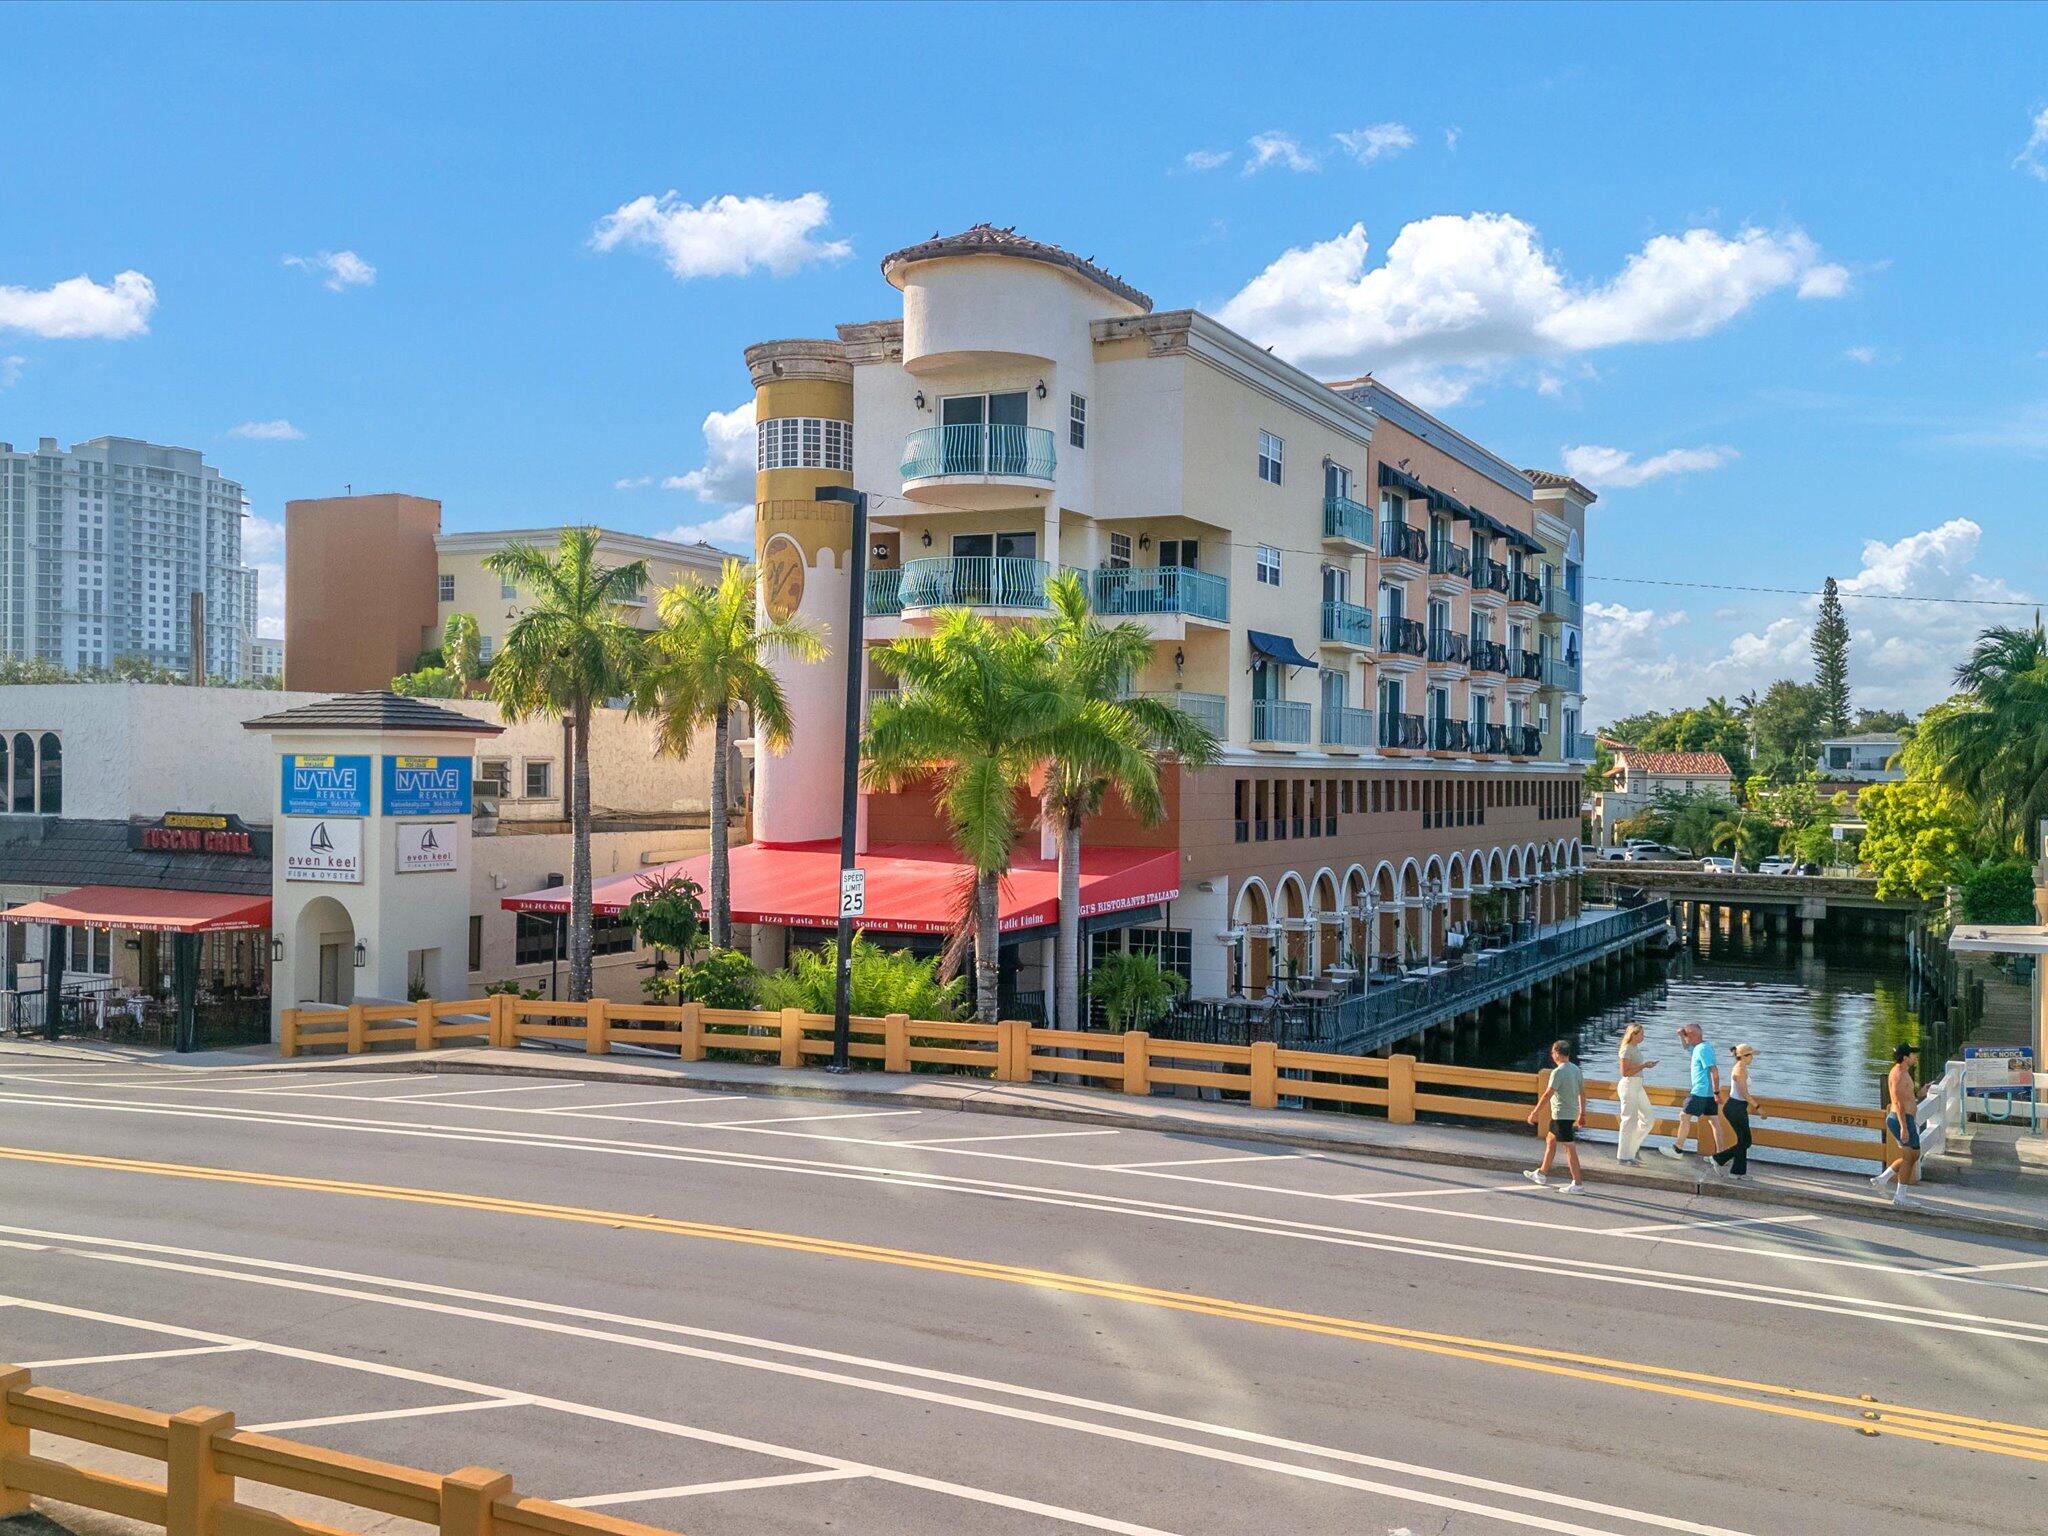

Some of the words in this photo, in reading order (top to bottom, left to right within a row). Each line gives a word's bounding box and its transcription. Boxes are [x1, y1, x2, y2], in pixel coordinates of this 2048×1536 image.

[297, 768, 353, 790] NATIVE
[399, 769, 456, 790] NATIVE
[316, 791, 355, 799] REALTY
[144, 828, 201, 850] TUSCAN
[205, 830, 252, 853] GRILL
[289, 856, 321, 867] even
[328, 855, 356, 868] keel
[432, 852, 451, 860] keel
[288, 870, 308, 878] FISH
[319, 872, 356, 880] OYSTER
[843, 874, 863, 882] SPEED
[845, 884, 861, 892] LIMIT
[843, 893, 863, 911] 25
[1098, 895, 1145, 912] RISTORANTE
[1146, 889, 1179, 903] ITALIANO
[760, 915, 783, 923] Pizza
[790, 917, 813, 925] Pasta
[855, 920, 888, 929] Seafood
[896, 922, 918, 930] Wine
[1021, 914, 1044, 926] Dining
